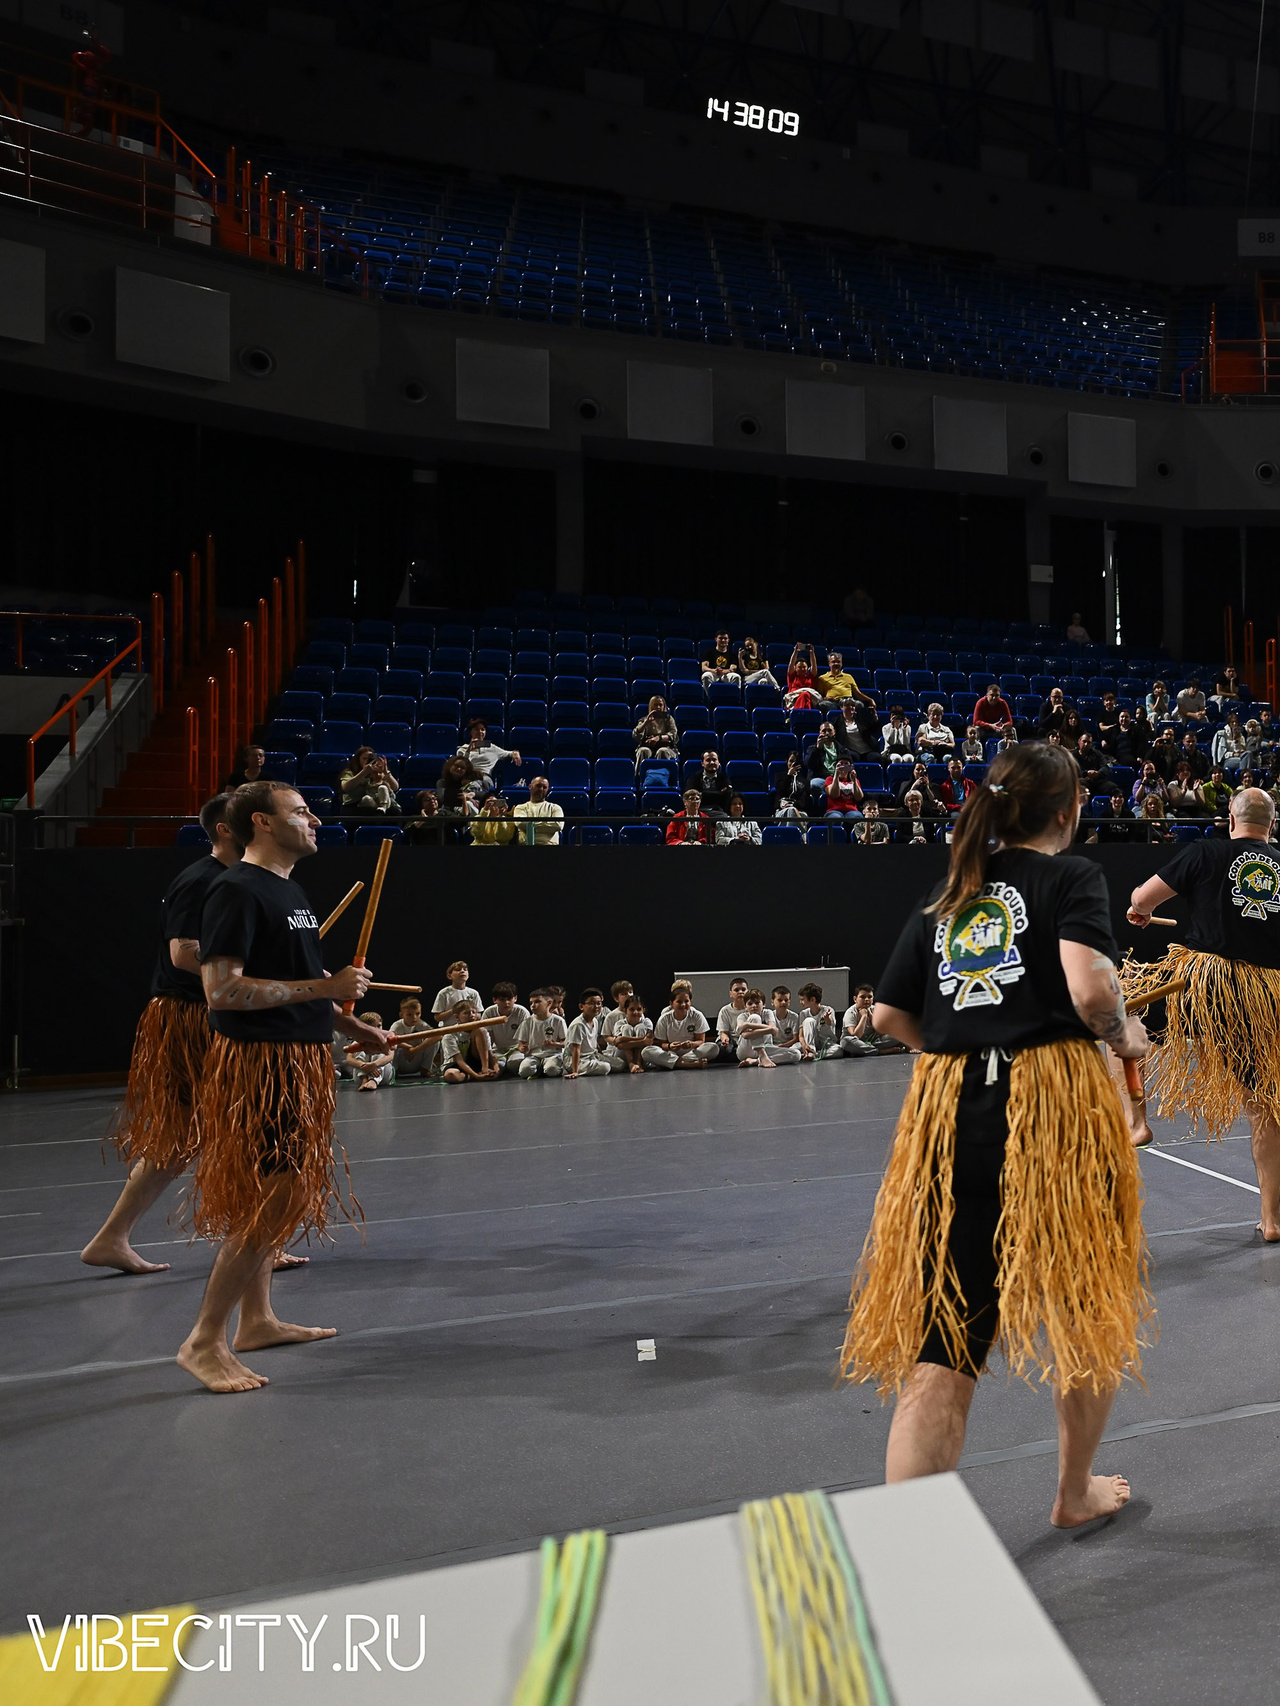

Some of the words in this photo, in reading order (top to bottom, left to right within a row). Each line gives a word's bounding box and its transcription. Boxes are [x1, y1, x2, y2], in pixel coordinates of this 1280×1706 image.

[706, 97, 730, 122] 14
[733, 101, 765, 130] 38
[767, 108, 800, 137] 09
[1258, 232, 1275, 244] B8
[1003, 889, 1025, 931] OURO
